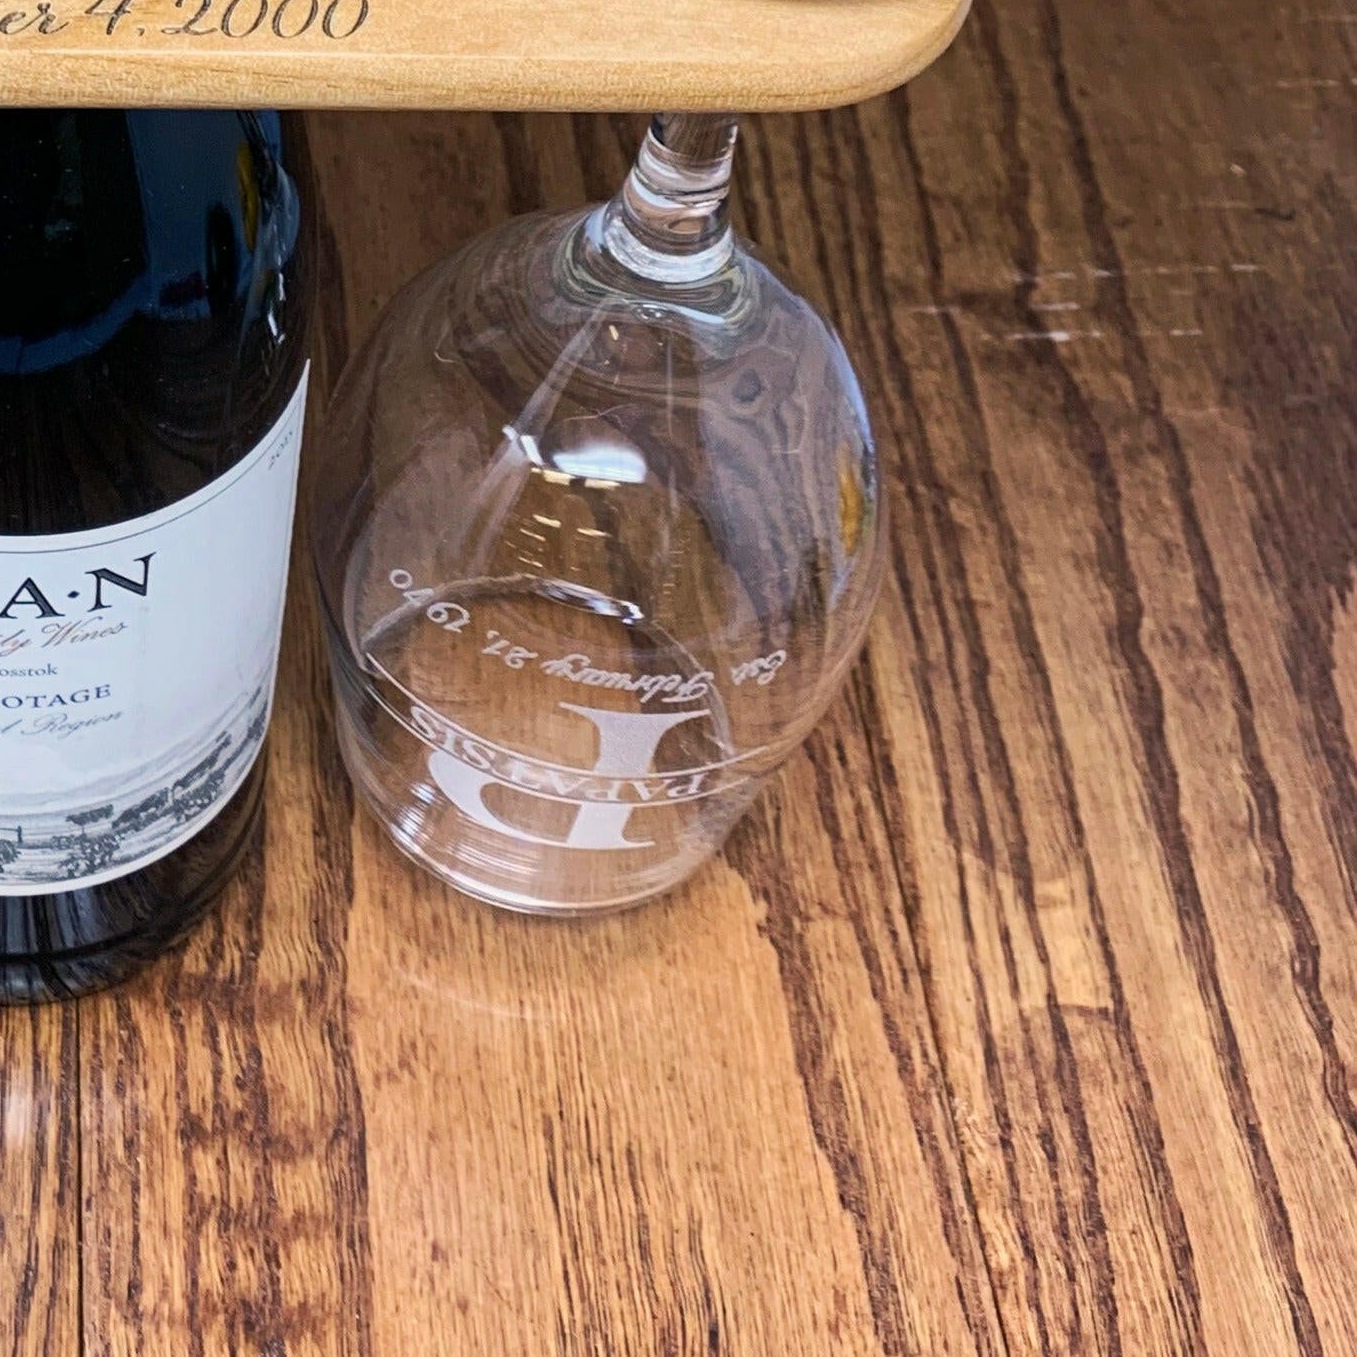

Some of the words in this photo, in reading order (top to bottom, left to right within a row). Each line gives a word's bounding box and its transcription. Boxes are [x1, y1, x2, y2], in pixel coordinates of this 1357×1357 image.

[40, 615, 130, 649] Wines
[482, 629, 539, 670] 21,
[541, 652, 715, 704] February
[19, 709, 126, 739] Region
[409, 704, 710, 803] PAPATSIS
